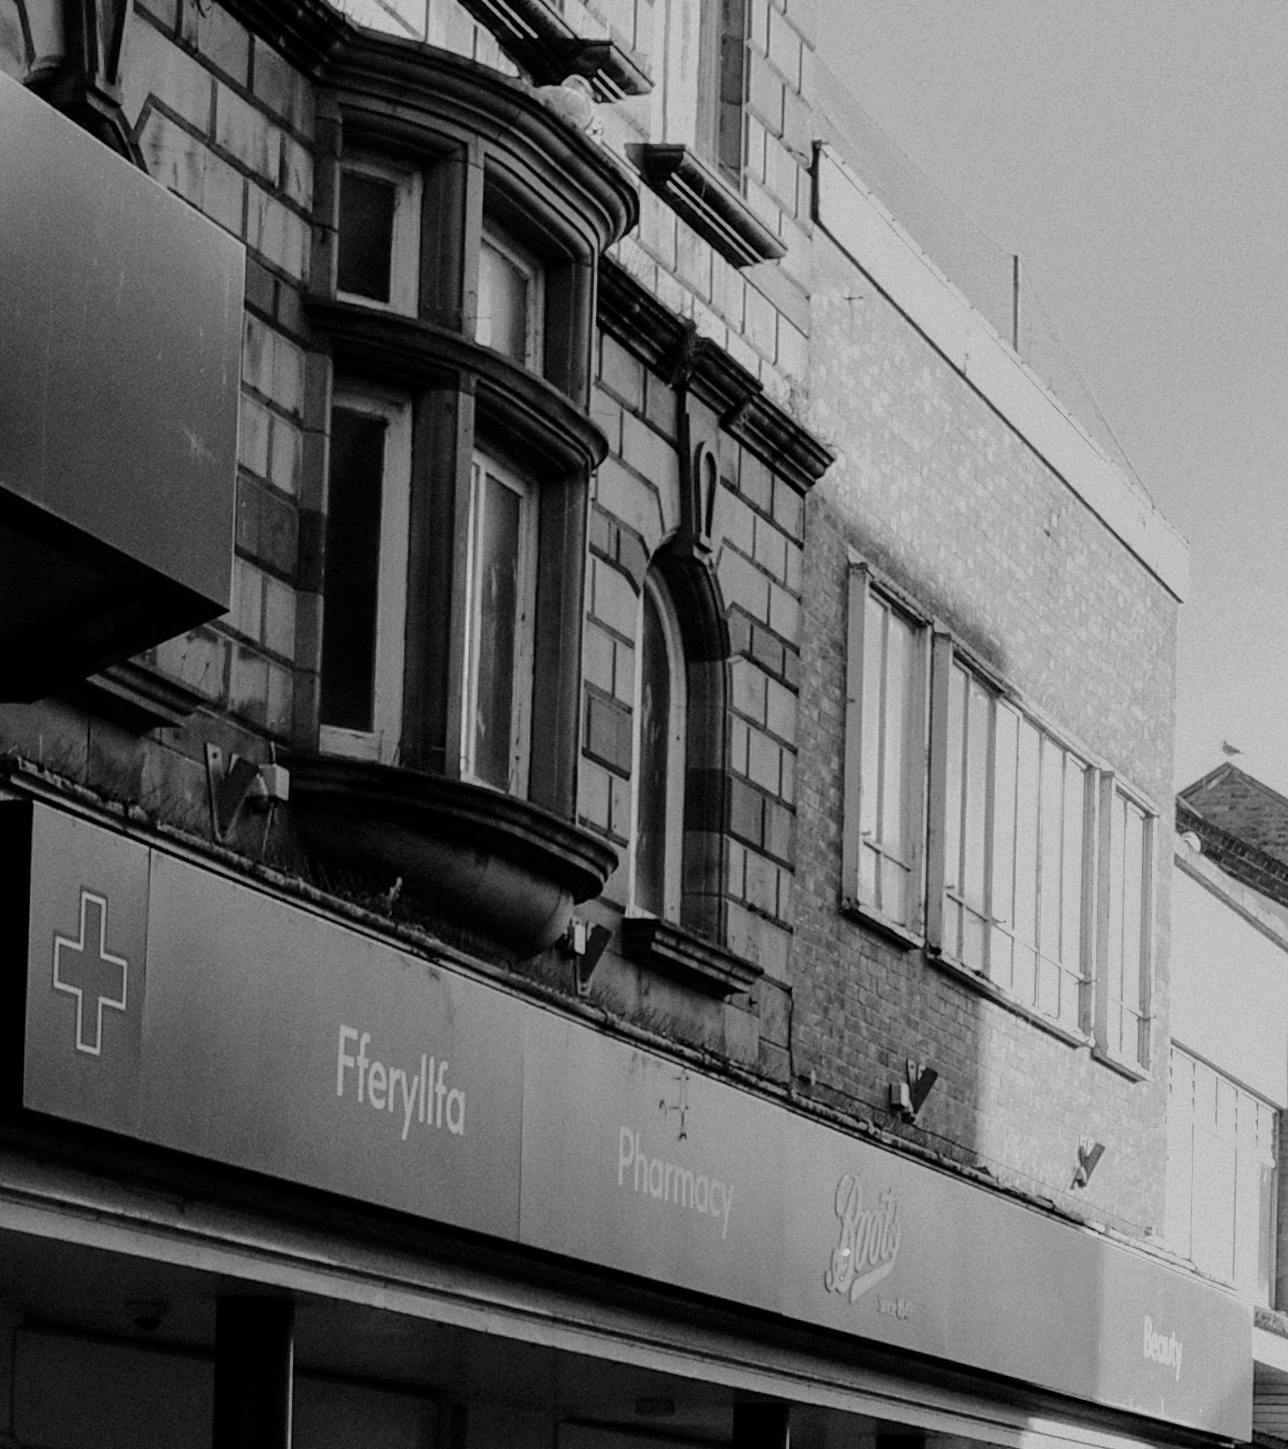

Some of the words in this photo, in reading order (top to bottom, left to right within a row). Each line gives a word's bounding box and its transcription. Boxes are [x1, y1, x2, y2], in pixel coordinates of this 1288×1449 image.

[337, 1024, 465, 1141] Fferyllfa
[618, 1126, 734, 1239] Pharmacy
[824, 1172, 900, 1304] Boots
[1143, 1315, 1183, 1382] Beauty
